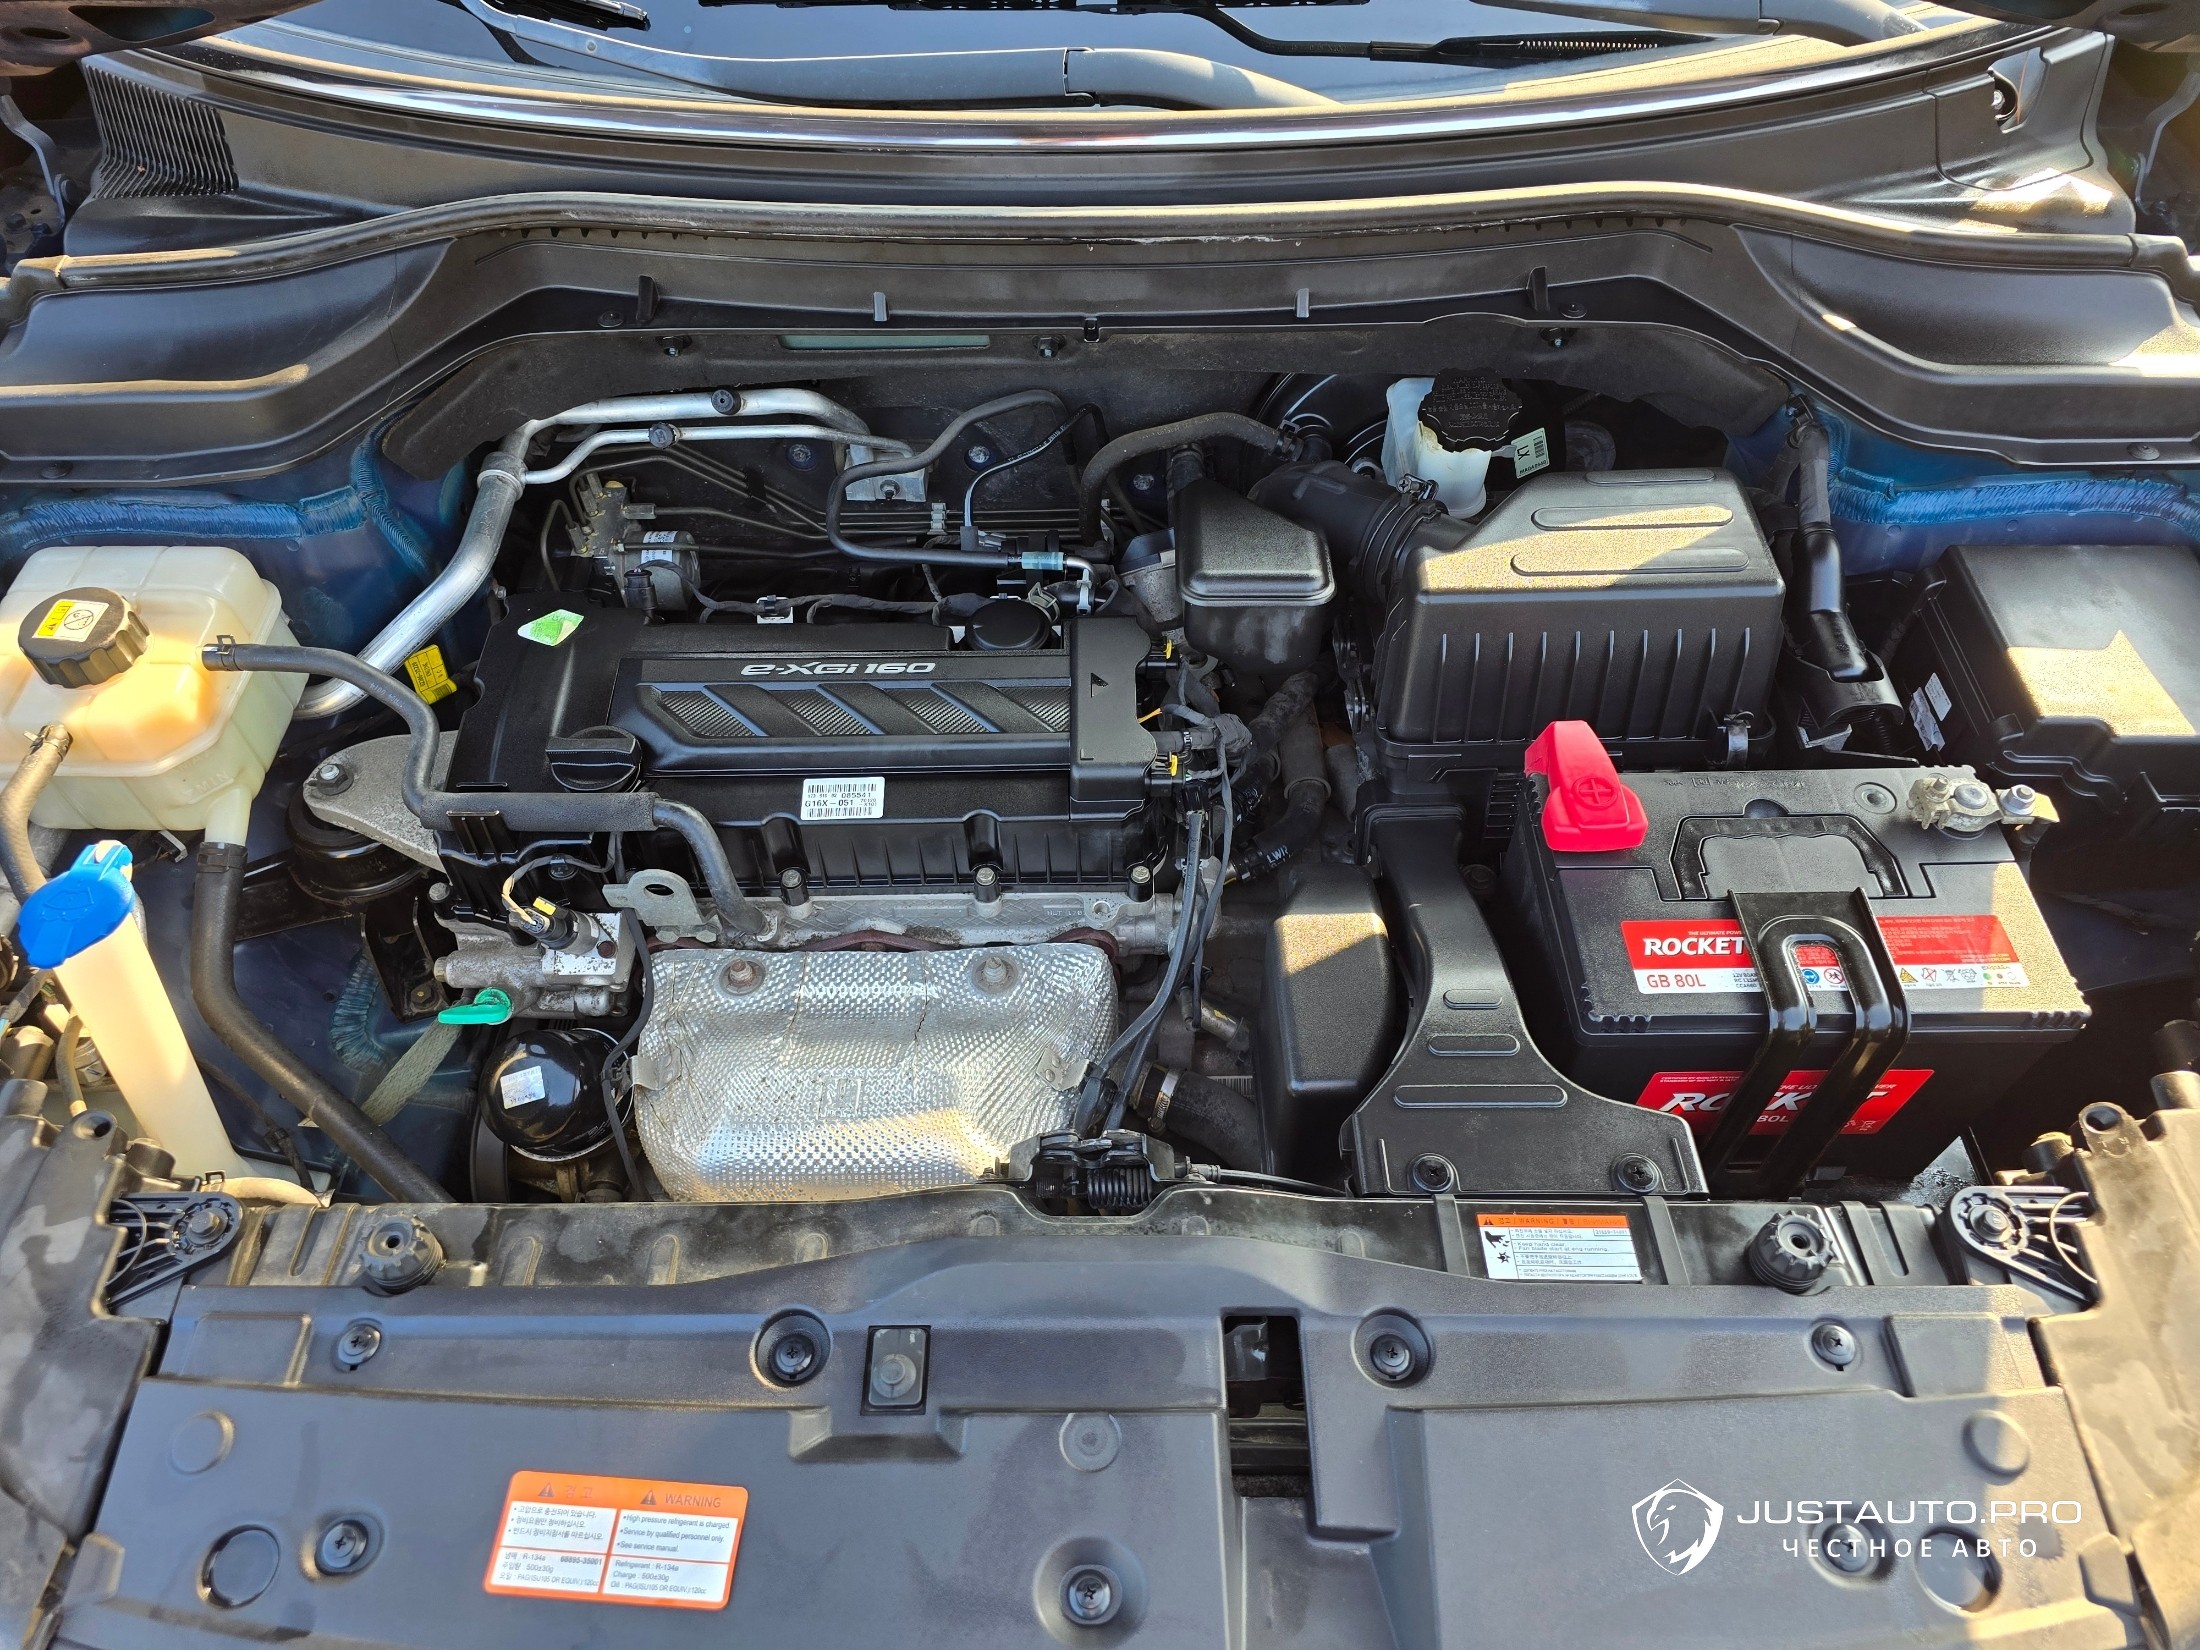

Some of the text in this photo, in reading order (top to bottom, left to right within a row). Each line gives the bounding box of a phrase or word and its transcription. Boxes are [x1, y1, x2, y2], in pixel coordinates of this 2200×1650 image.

[1517, 445, 1530, 460] LX
[864, 662, 936, 675] 160
[1643, 937, 1745, 956] ROCKET
[1646, 974, 1706, 988] GB 80L
[1518, 1217, 1554, 1225] WARNING
[665, 1493, 721, 1508] WARNING
[626, 1514, 730, 1530] High pressure refrigerant is charged.
[623, 1527, 724, 1543] Service by qualified personnel only.
[620, 1541, 679, 1552] See service manual.
[522, 1553, 546, 1561] R-134a
[655, 1562, 679, 1572] R-134a
[612, 1570, 636, 1580] Charge
